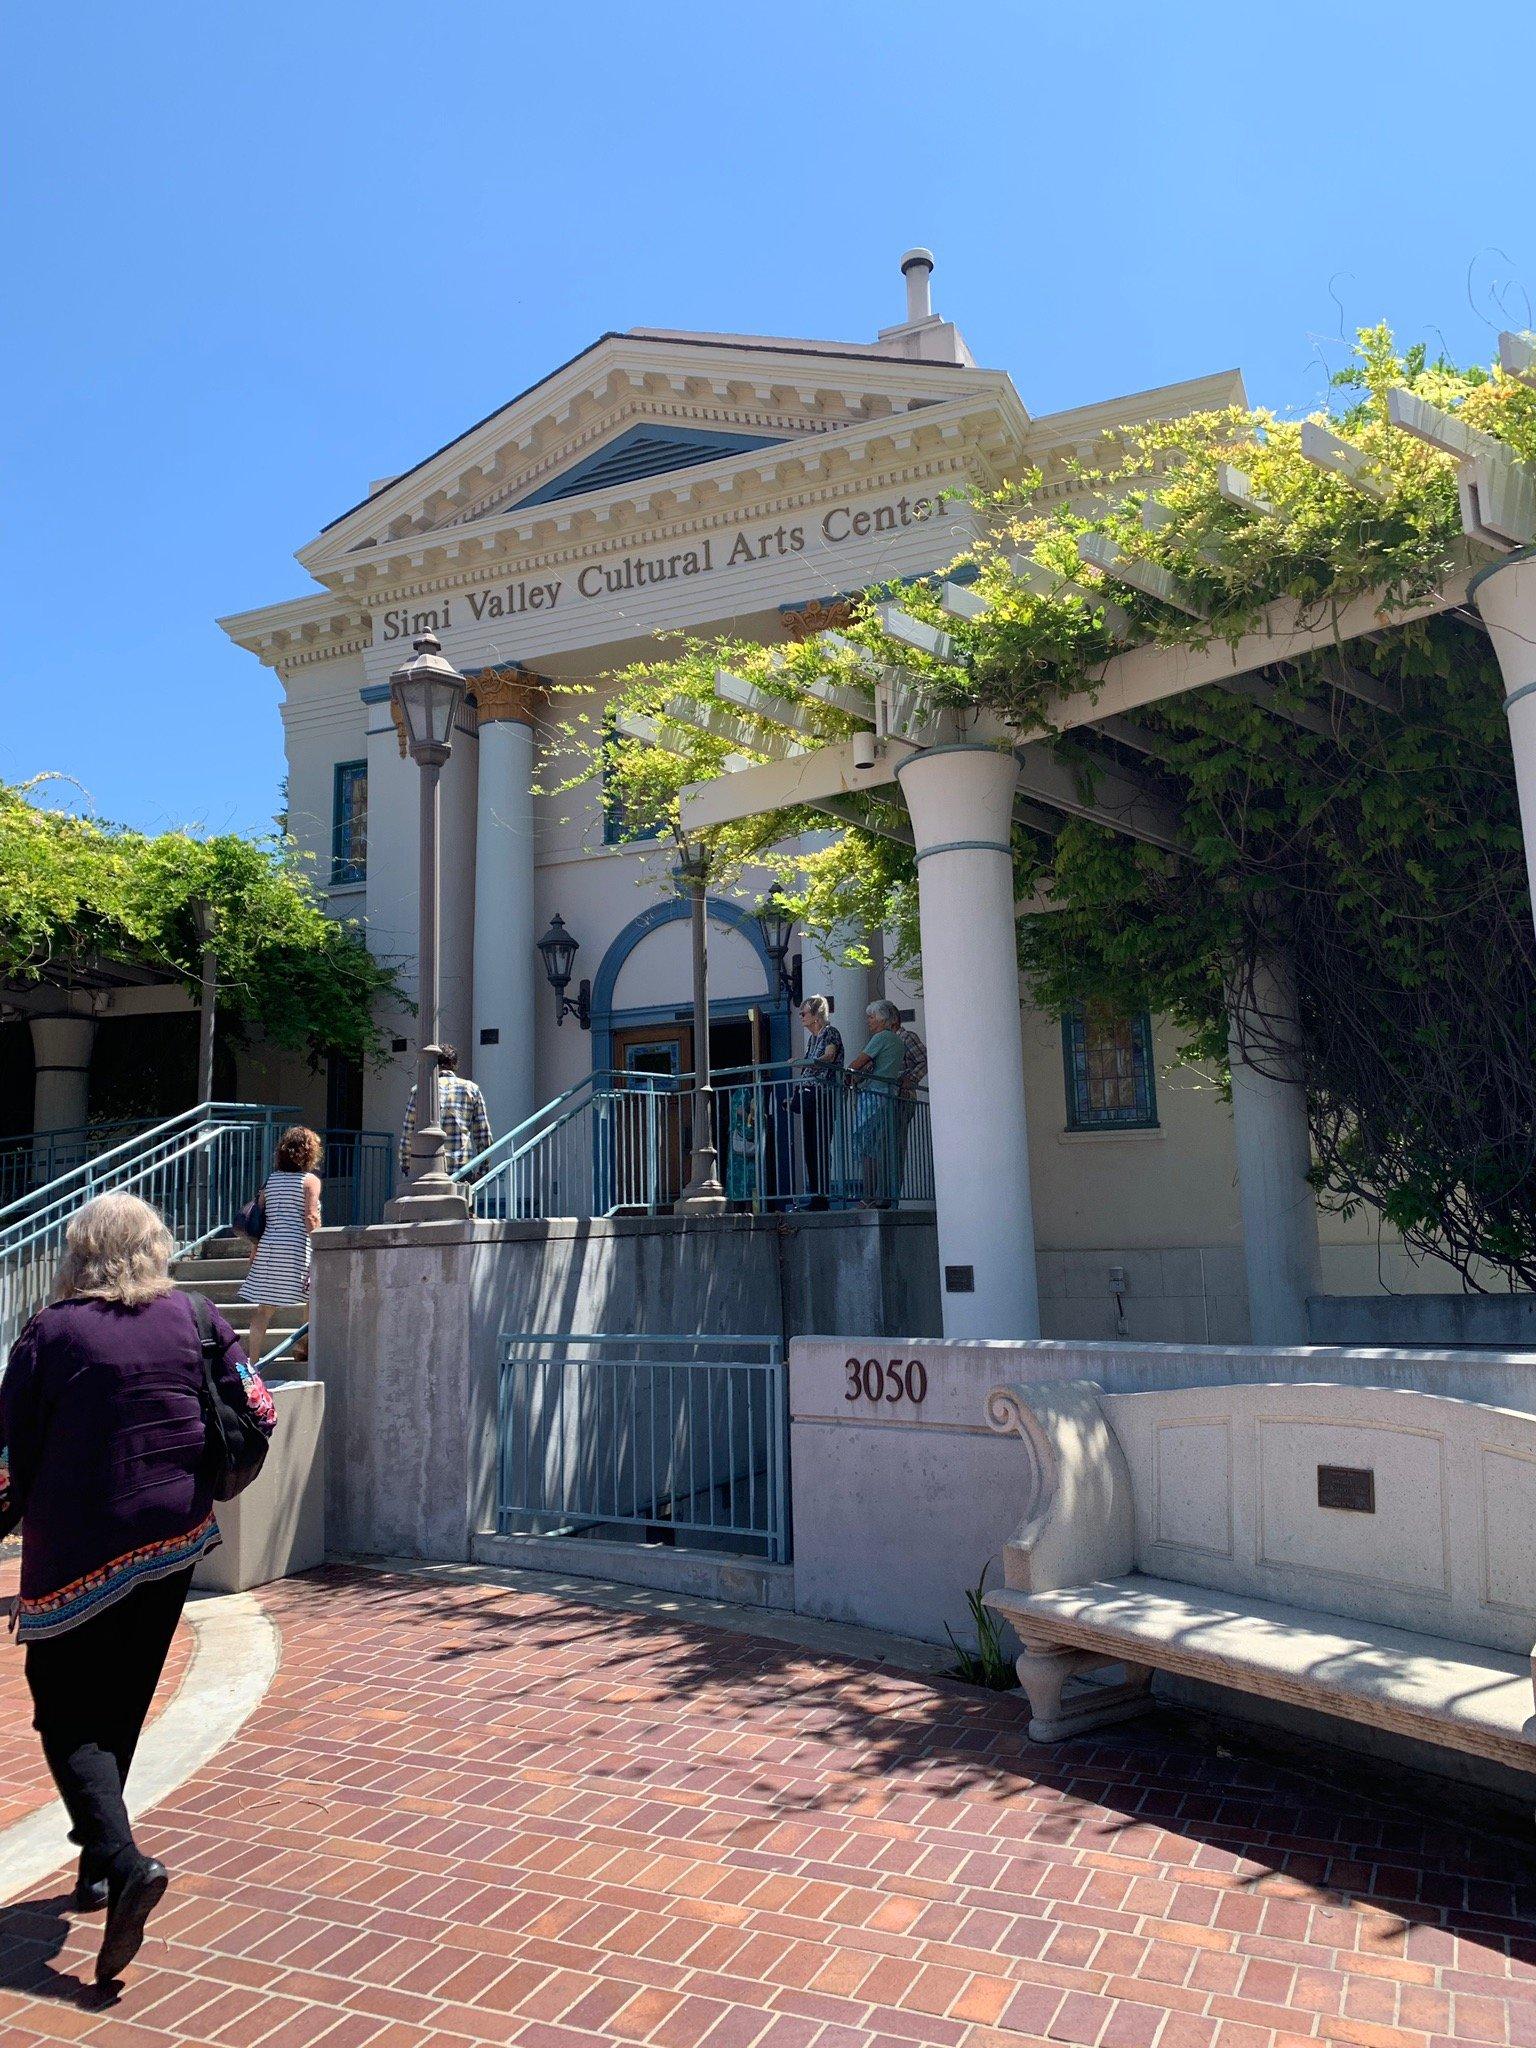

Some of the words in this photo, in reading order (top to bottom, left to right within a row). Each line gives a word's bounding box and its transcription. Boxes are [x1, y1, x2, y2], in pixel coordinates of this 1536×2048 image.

[384, 600, 452, 641] Simi
[465, 581, 562, 621] Valley
[578, 539, 713, 597] Cultural
[727, 525, 805, 566] Arts
[821, 495, 949, 542] Center
[845, 1358, 927, 1403] 3050
